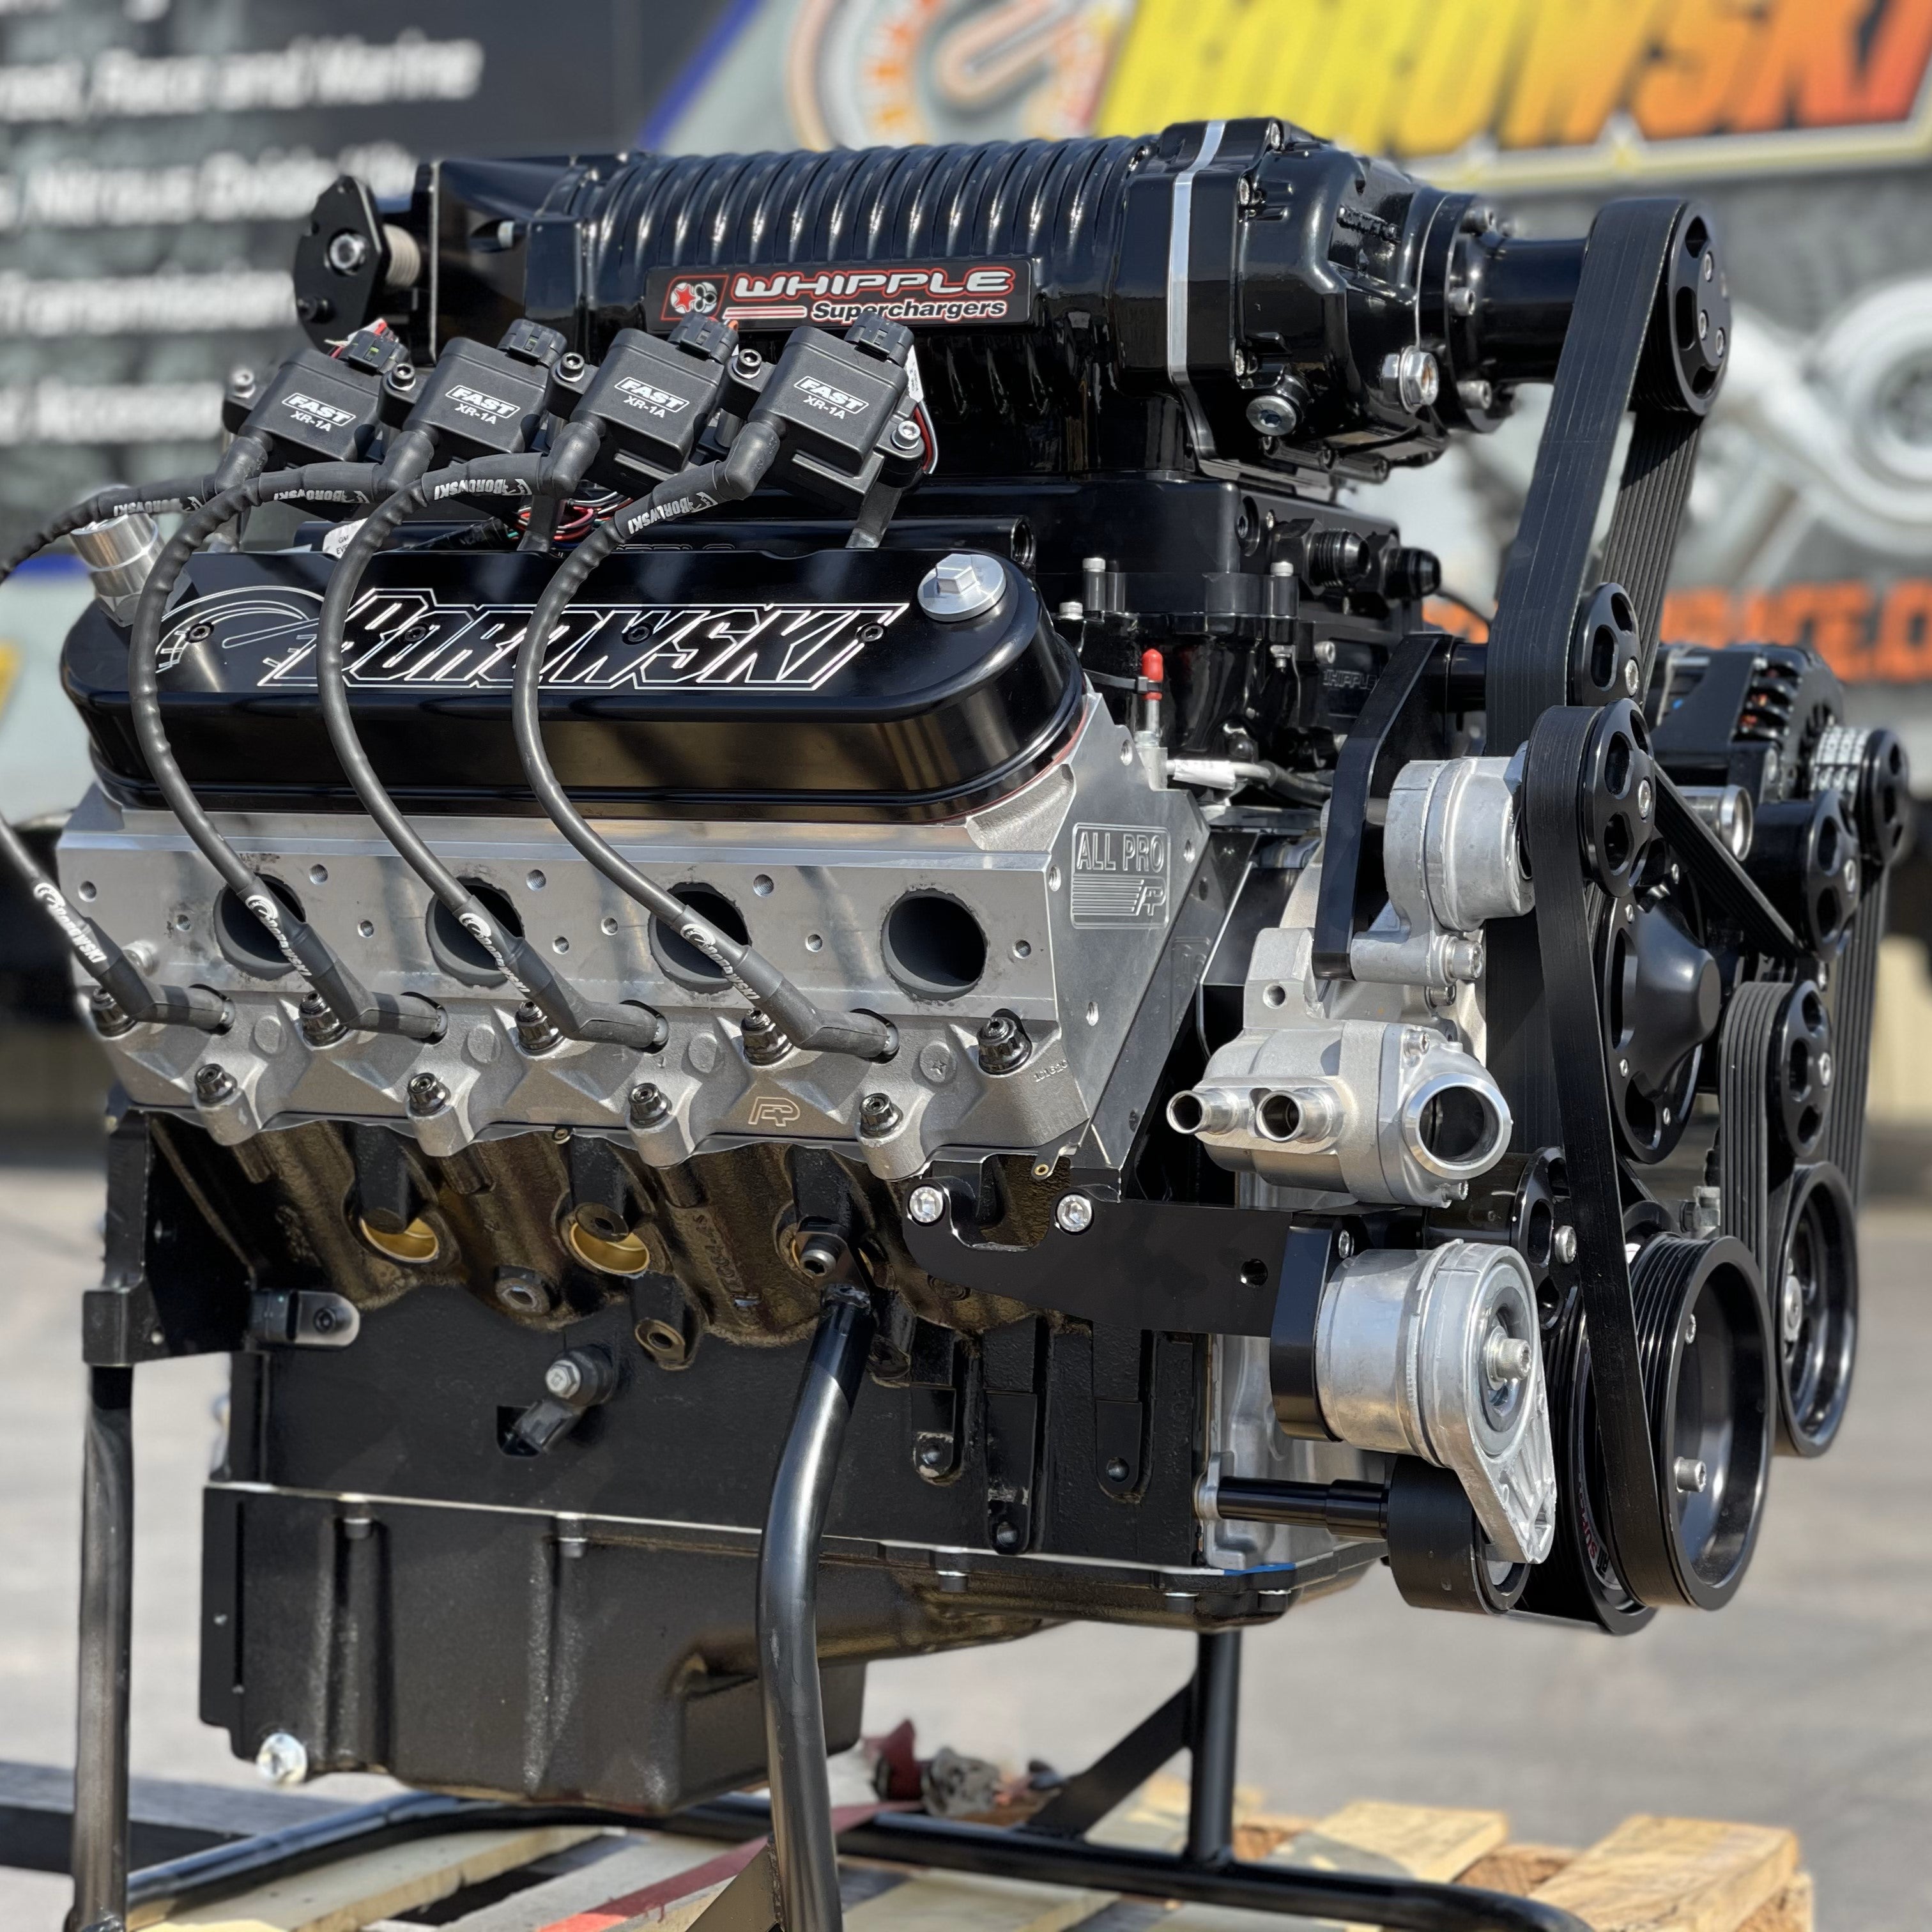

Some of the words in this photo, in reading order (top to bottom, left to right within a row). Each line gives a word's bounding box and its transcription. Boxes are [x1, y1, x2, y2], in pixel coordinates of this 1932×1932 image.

[732, 268, 1014, 300] WHIPPLE
[452, 388, 515, 415] FAST
[621, 380, 684, 408] FAST
[624, 395, 666, 418] XR-1A
[799, 379, 864, 413] FAST
[803, 394, 847, 420] XR-1A
[288, 395, 351, 423] FAST
[290, 411, 332, 432] XR-1A
[455, 403, 497, 425] XR-1A
[1077, 831, 1117, 871] ALL
[1123, 833, 1165, 873] PRO
